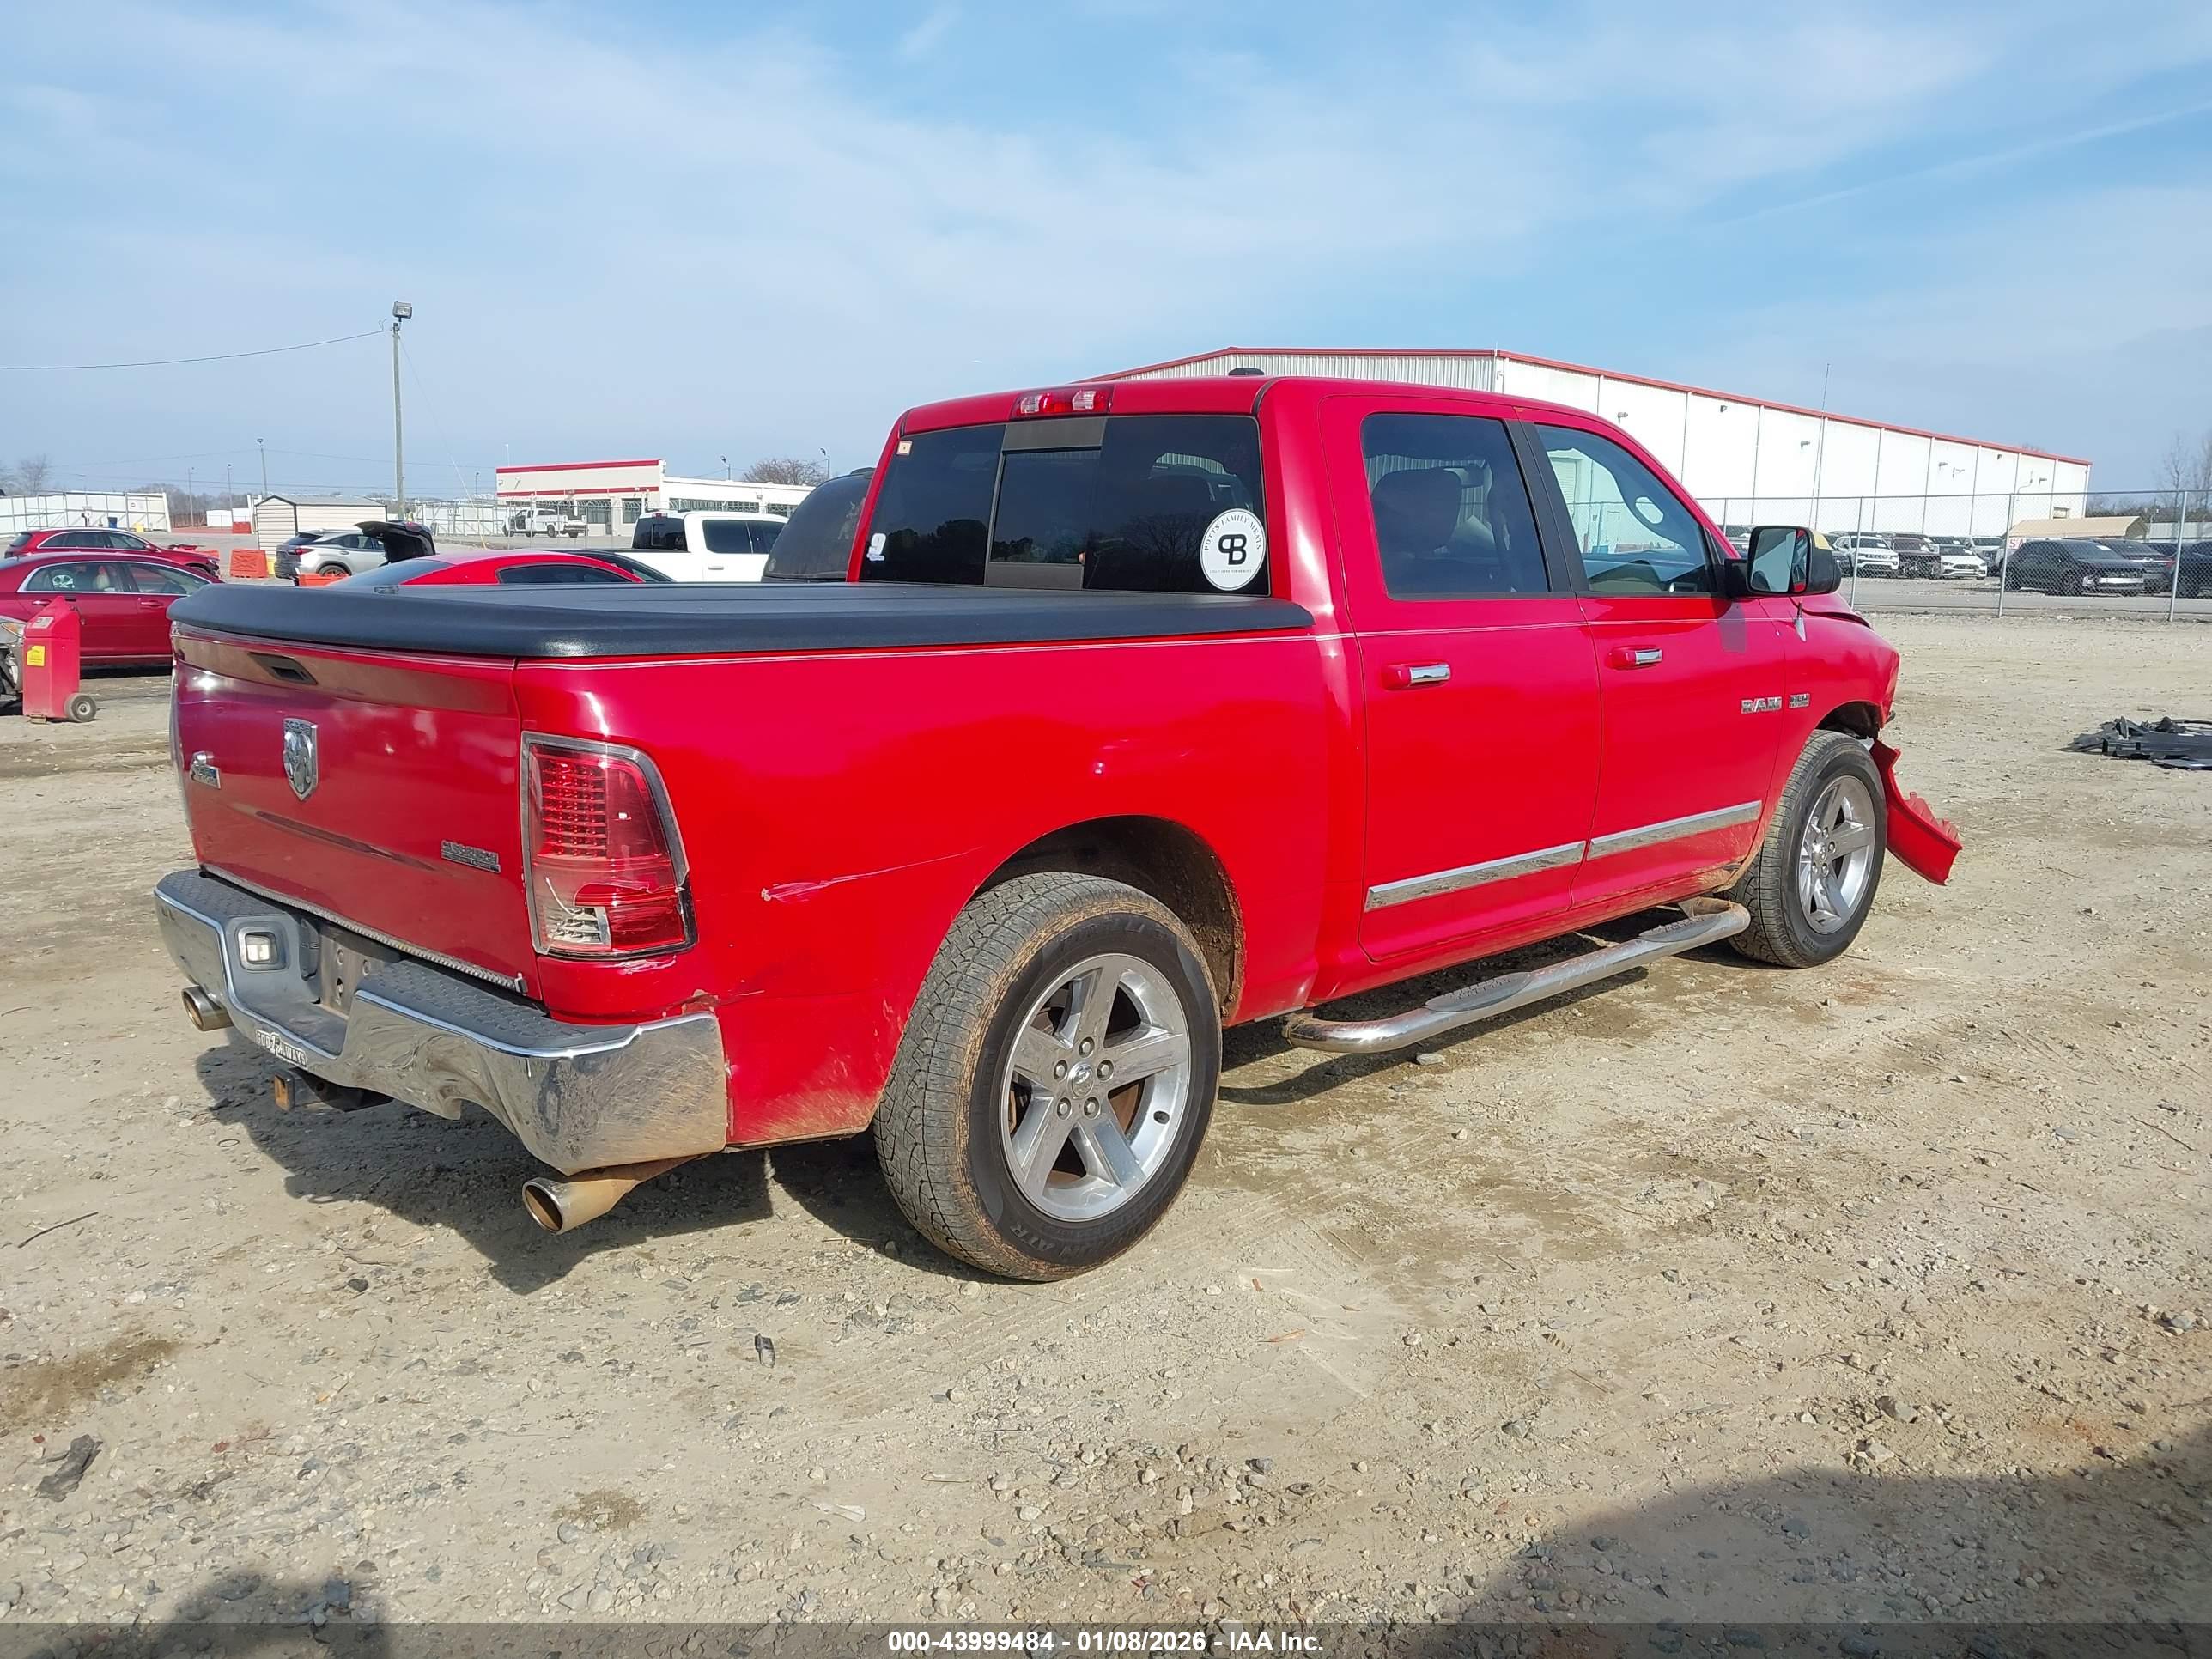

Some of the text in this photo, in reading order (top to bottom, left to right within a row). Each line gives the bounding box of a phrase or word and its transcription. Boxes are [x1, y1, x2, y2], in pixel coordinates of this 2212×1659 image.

[1204, 514, 1262, 550] POTTS FAMILY MEATS
[1741, 696, 1783, 714] RAM
[278, 1042, 306, 1066] ALWAYS
